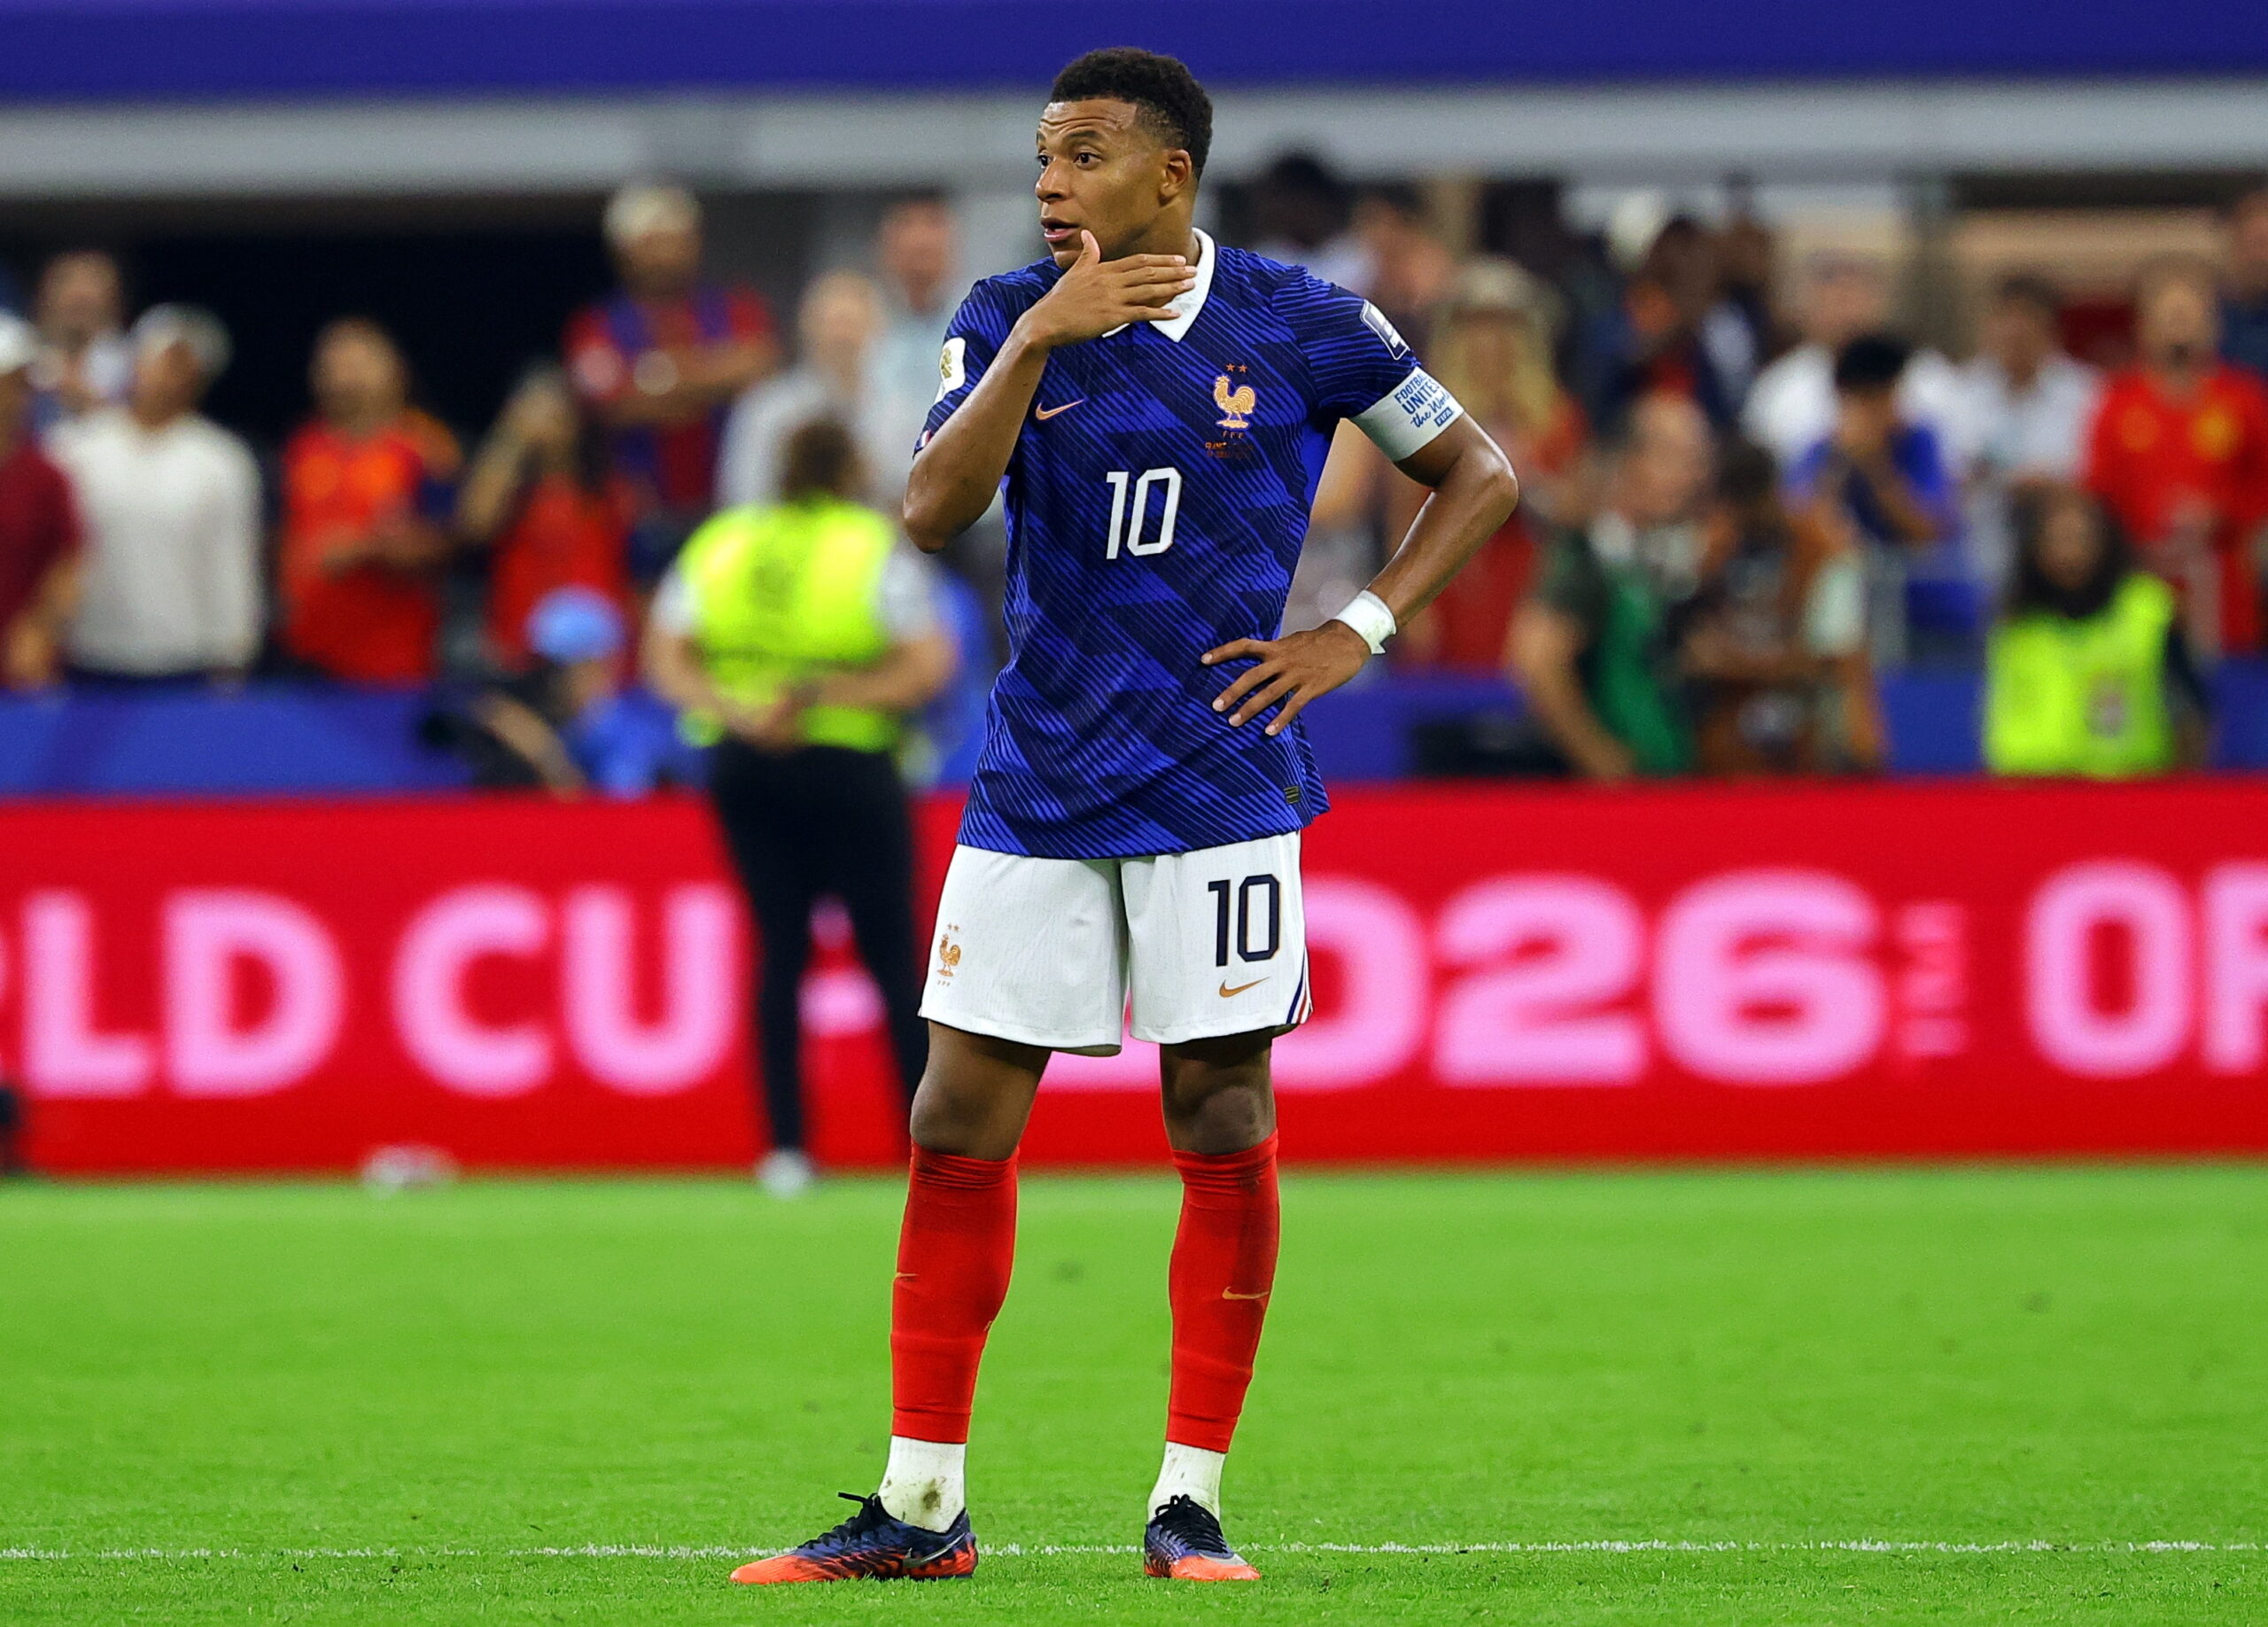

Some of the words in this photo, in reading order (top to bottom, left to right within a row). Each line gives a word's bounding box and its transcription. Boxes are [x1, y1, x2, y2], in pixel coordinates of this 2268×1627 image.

[1402, 378, 1440, 415] UNITES
[1410, 411, 1431, 428] the
[1436, 409, 1452, 425] FIFA
[1106, 467, 1182, 560] 10
[1208, 873, 1281, 967] 10
[0, 888, 346, 1097] LD
